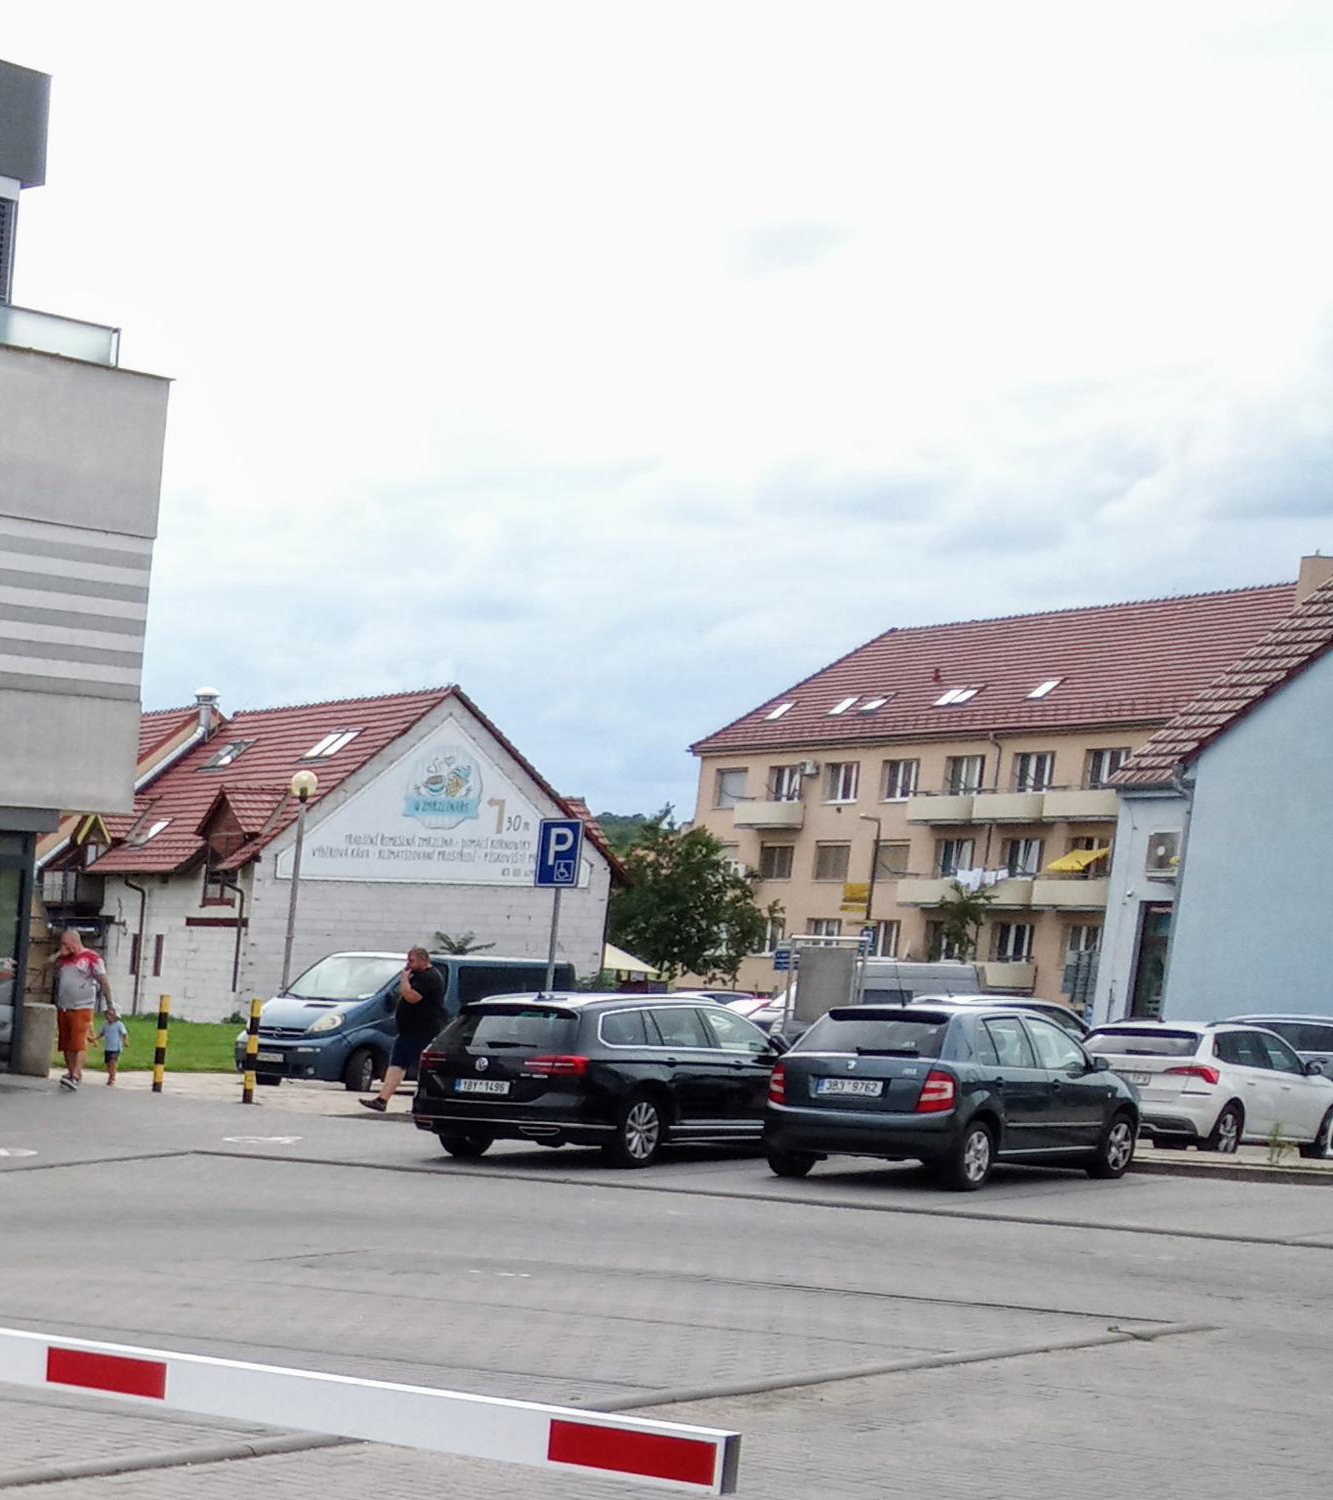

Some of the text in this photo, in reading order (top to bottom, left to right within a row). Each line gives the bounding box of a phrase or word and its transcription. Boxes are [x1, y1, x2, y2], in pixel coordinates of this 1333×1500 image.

[505, 815, 522, 832] 30
[547, 827, 574, 866] P
[853, 1081, 878, 1094] 9762
